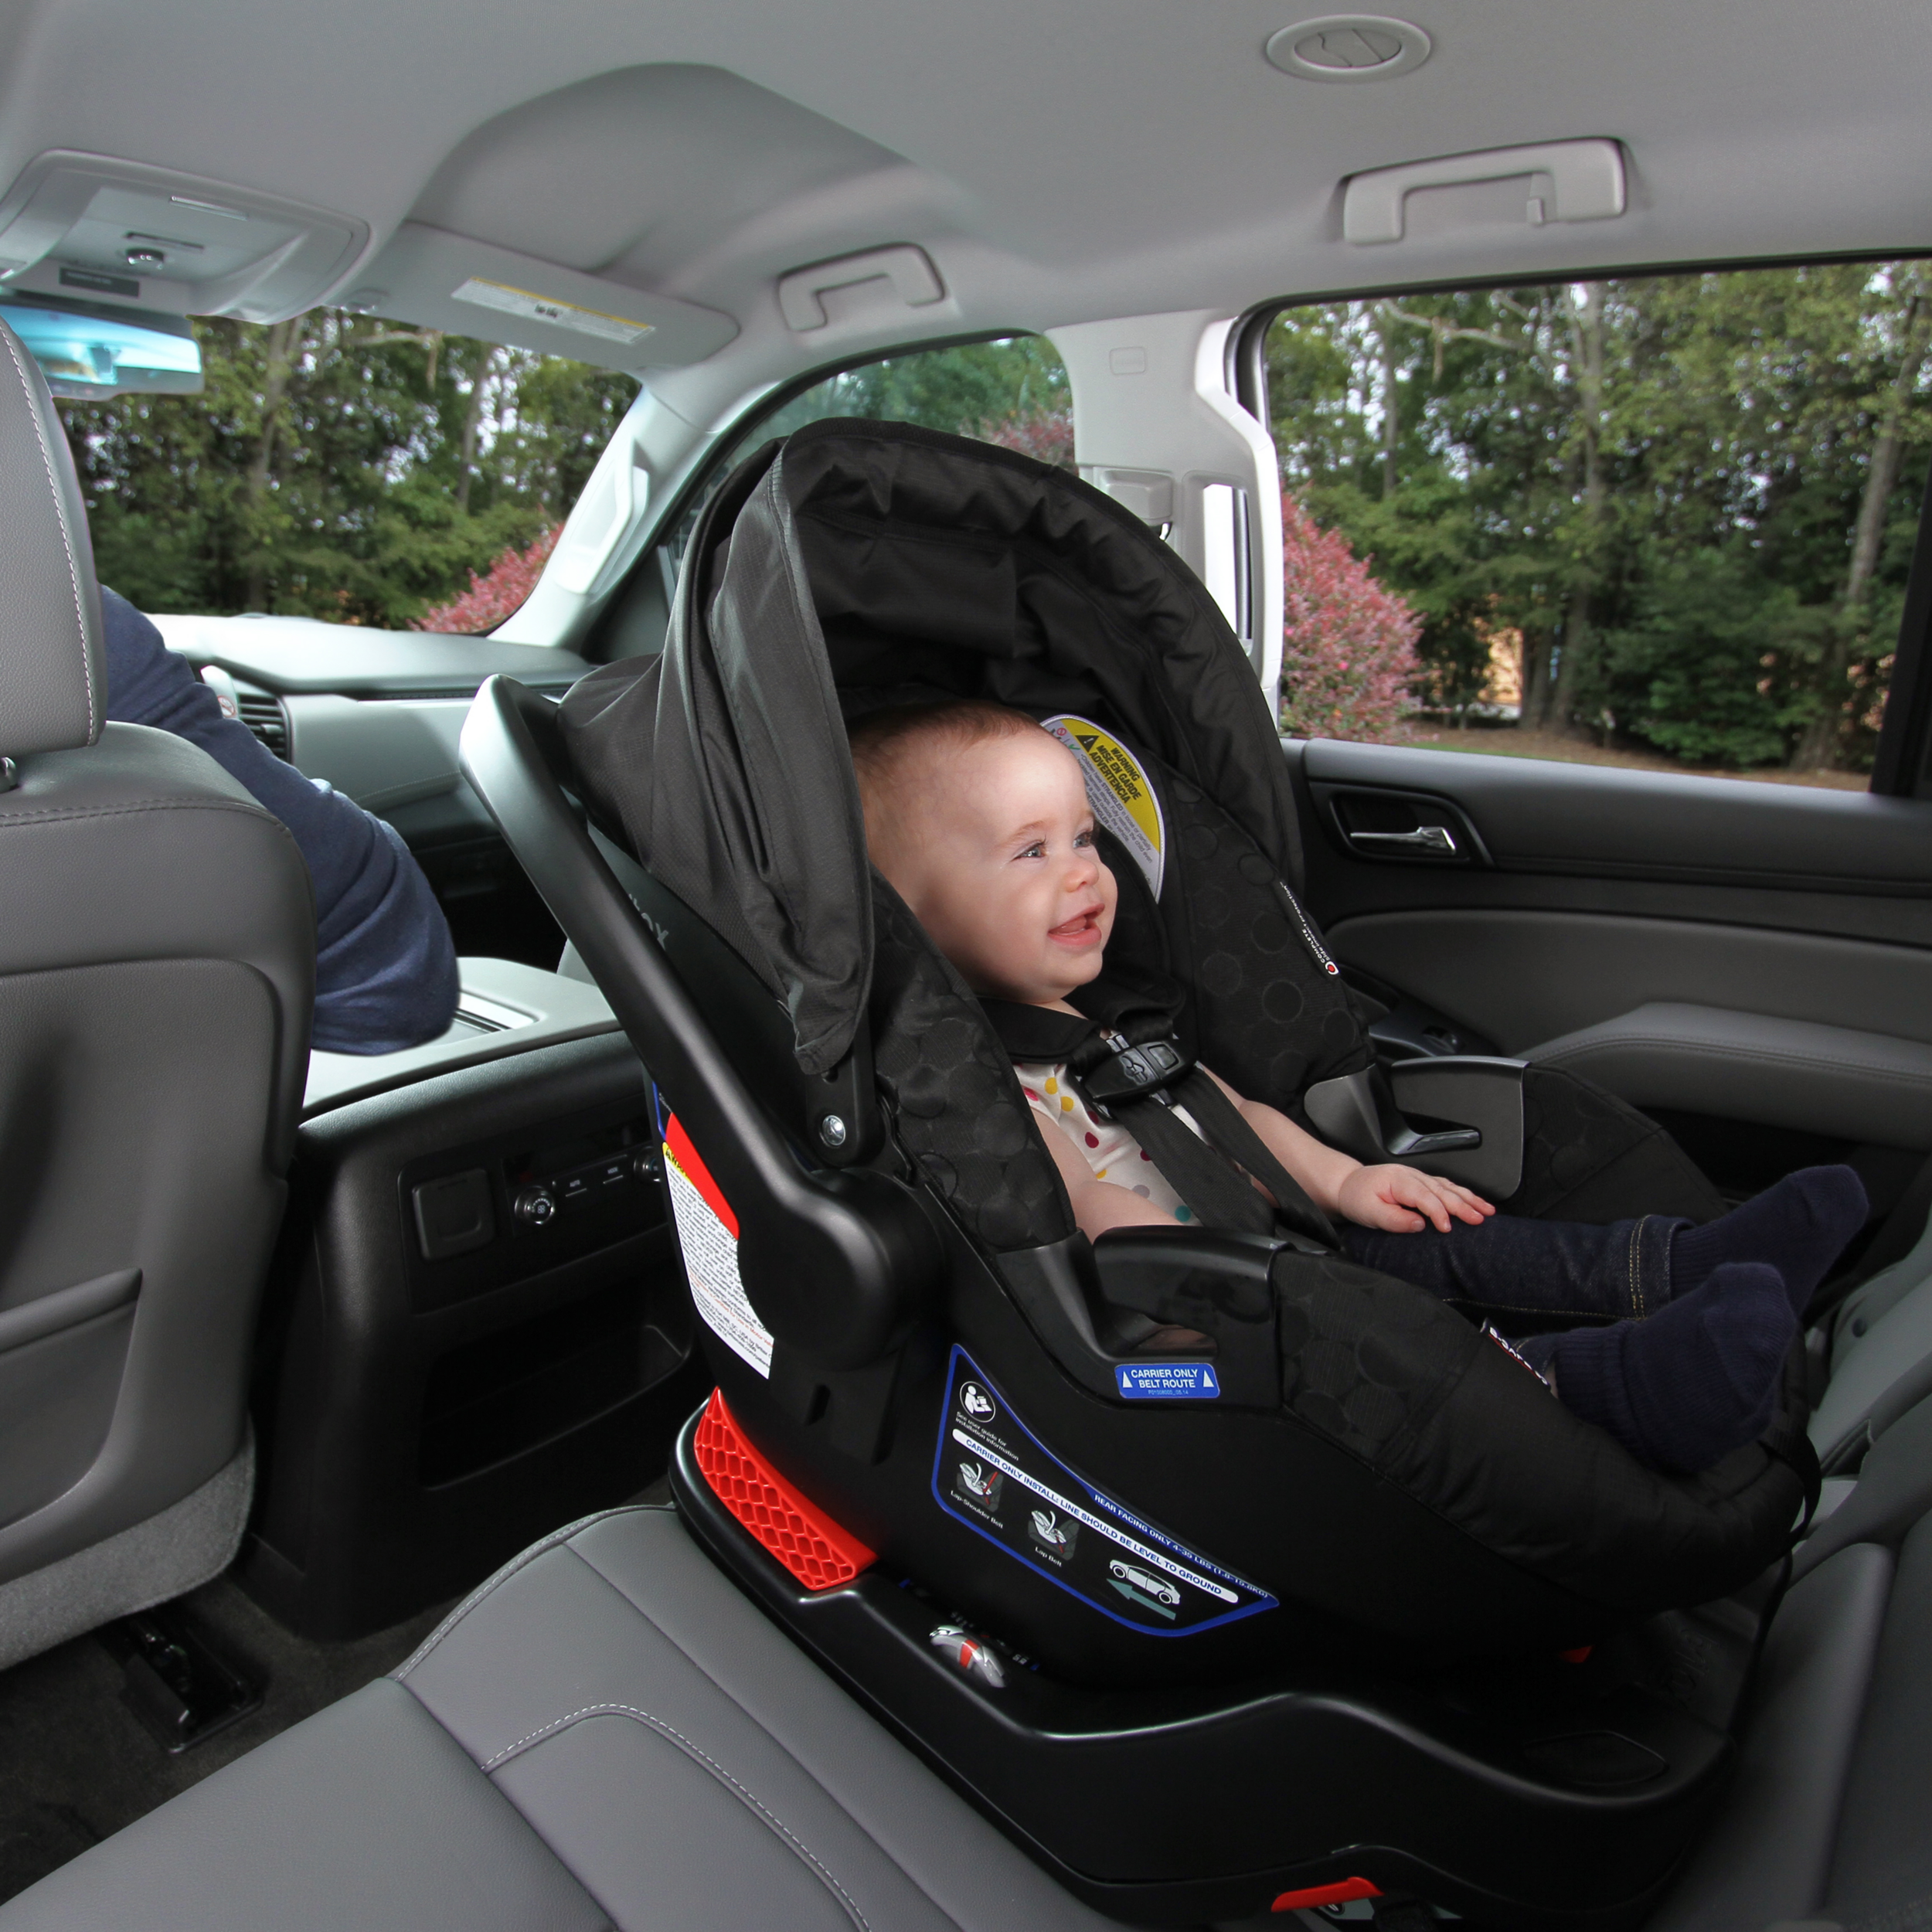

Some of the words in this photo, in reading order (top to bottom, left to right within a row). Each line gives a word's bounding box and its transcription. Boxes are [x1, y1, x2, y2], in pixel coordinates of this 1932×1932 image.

[1090, 750, 1131, 803] ADVERTENCIA
[1096, 745, 1114, 764] MISE
[1110, 762, 1123, 774] EN
[1118, 773, 1141, 800] GARDE
[1111, 746, 1140, 781] WARNING
[1087, 774, 1101, 792] harness
[1110, 805, 1119, 818] Fully
[1134, 840, 1145, 852] child
[1142, 852, 1153, 863] even
[1091, 791, 1102, 803] used
[1099, 802, 1113, 818] outside
[1094, 772, 1103, 784] have
[1101, 782, 1124, 811] STRANGLED
[1124, 815, 1135, 828] loose
[1136, 833, 1151, 851] partially
[1302, 929, 1325, 963] COMPLETE
[1303, 923, 1320, 947] impact
[1318, 947, 1331, 961] side
[1131, 1369, 1172, 1378] CARRIER
[1138, 1379, 1161, 1388] BELT
[1163, 1379, 1196, 1388] ROUTE
[955, 1417, 988, 1439] installation
[986, 1437, 1019, 1461] information
[957, 1411, 968, 1421] See
[968, 1420, 981, 1430] user
[981, 1428, 997, 1440] guide
[998, 1438, 1006, 1447] for
[951, 1490, 991, 1521] Lap-Shoulder
[991, 1518, 1003, 1529] Belt
[966, 1439, 1000, 1467] CARRIER
[1002, 1462, 1022, 1479] ONLY
[1024, 1476, 1059, 1504] INSTALL:
[1060, 1499, 1079, 1516] LINE
[1081, 1512, 1117, 1538] SHOULD
[1120, 1536, 1132, 1547] BE
[1134, 1544, 1161, 1564] LEVEL
[1165, 1561, 1176, 1572] TO
[1179, 1568, 1221, 1595] GROUND
[1095, 1495, 1116, 1512] REAR
[1118, 1510, 1148, 1532] FACING
[1150, 1529, 1171, 1546] ONLY
[1172, 1545, 1192, 1559] 4-35
[1195, 1556, 1211, 1570] LBS
[1035, 1546, 1048, 1560] Lap
[1049, 1554, 1062, 1567] Belt
